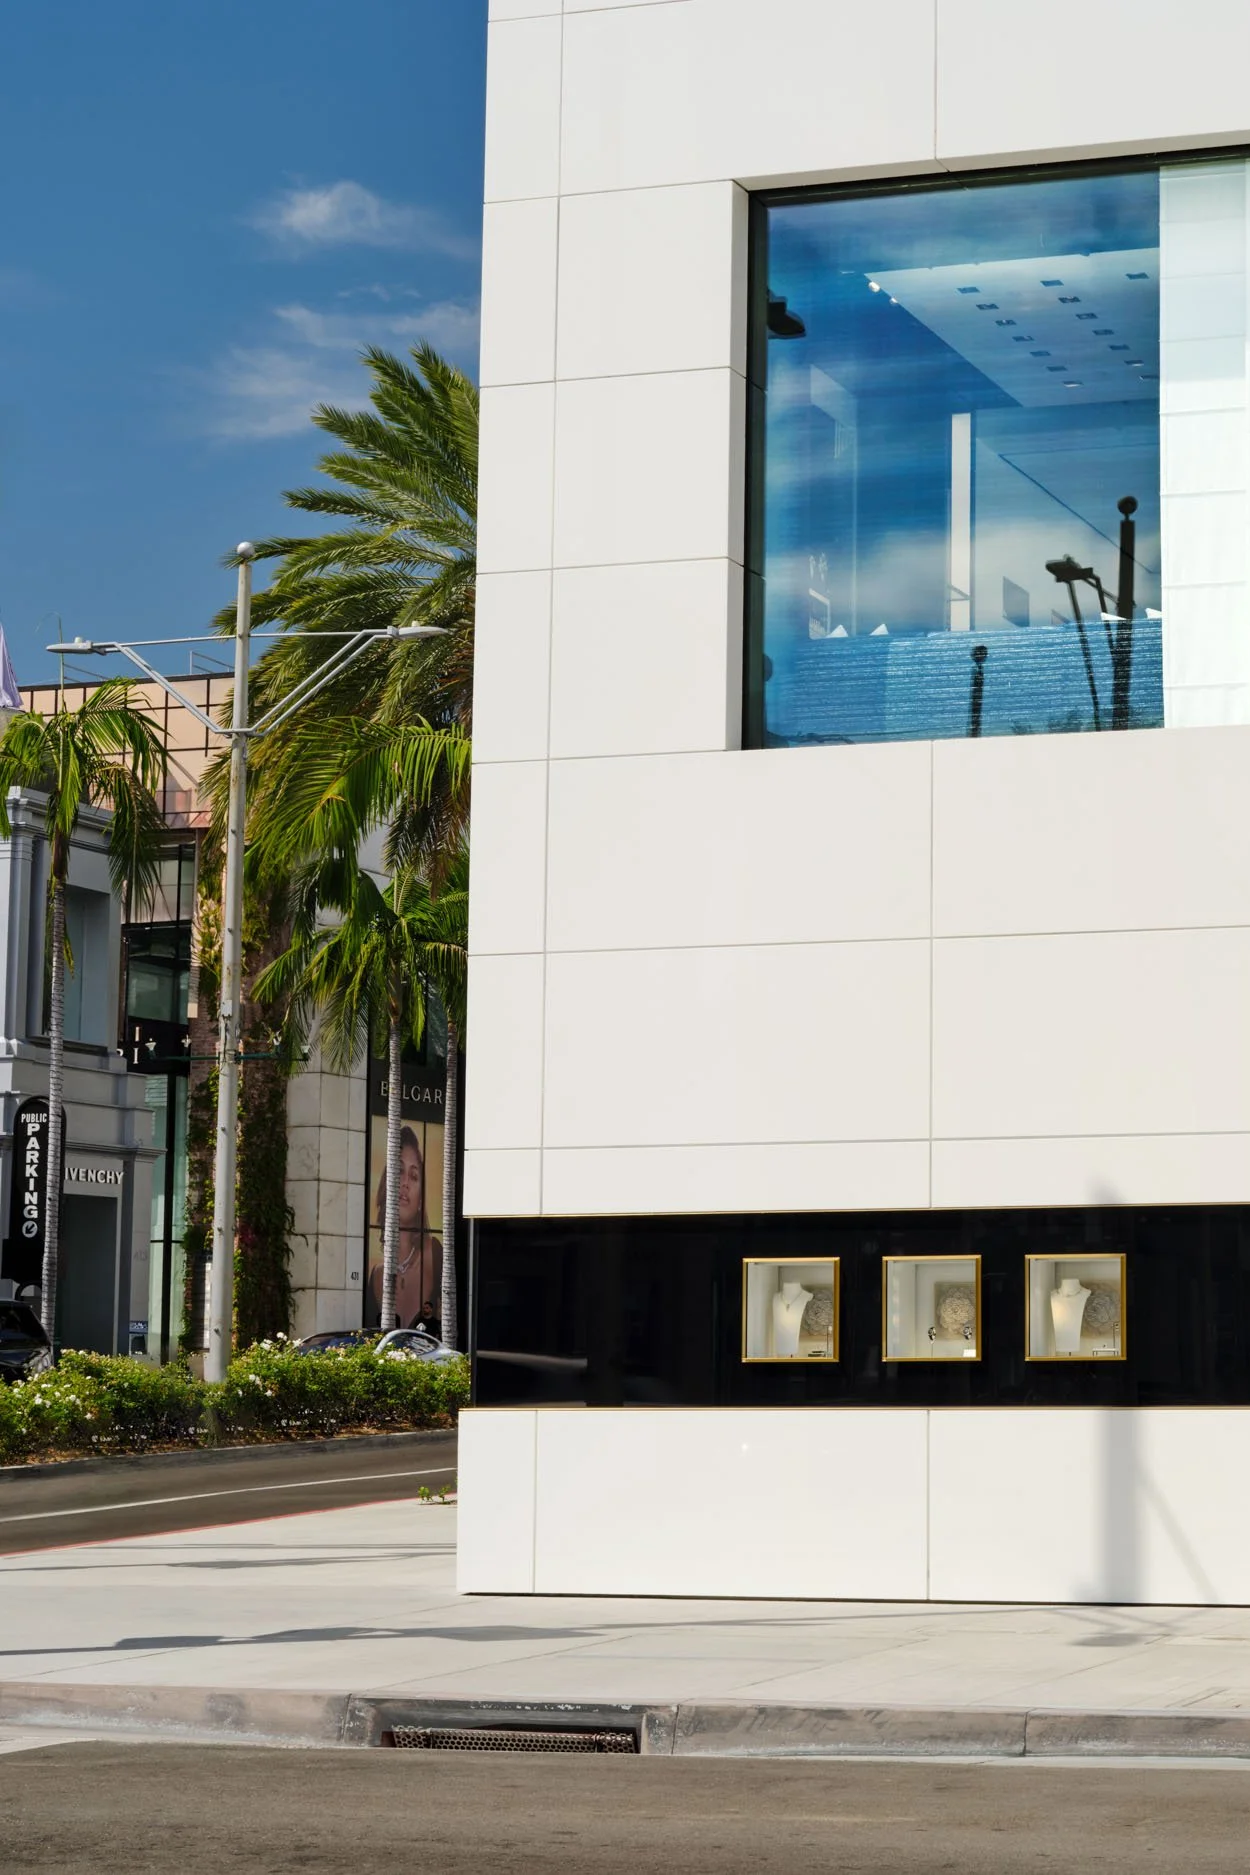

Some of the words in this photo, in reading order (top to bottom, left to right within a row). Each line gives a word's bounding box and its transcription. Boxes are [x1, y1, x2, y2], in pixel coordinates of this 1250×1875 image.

[381, 1081, 443, 1104] BLGAR
[21, 1113, 48, 1123] PUBLIC
[23, 1123, 40, 1219] PARKING
[65, 1167, 124, 1185] IVENCHY
